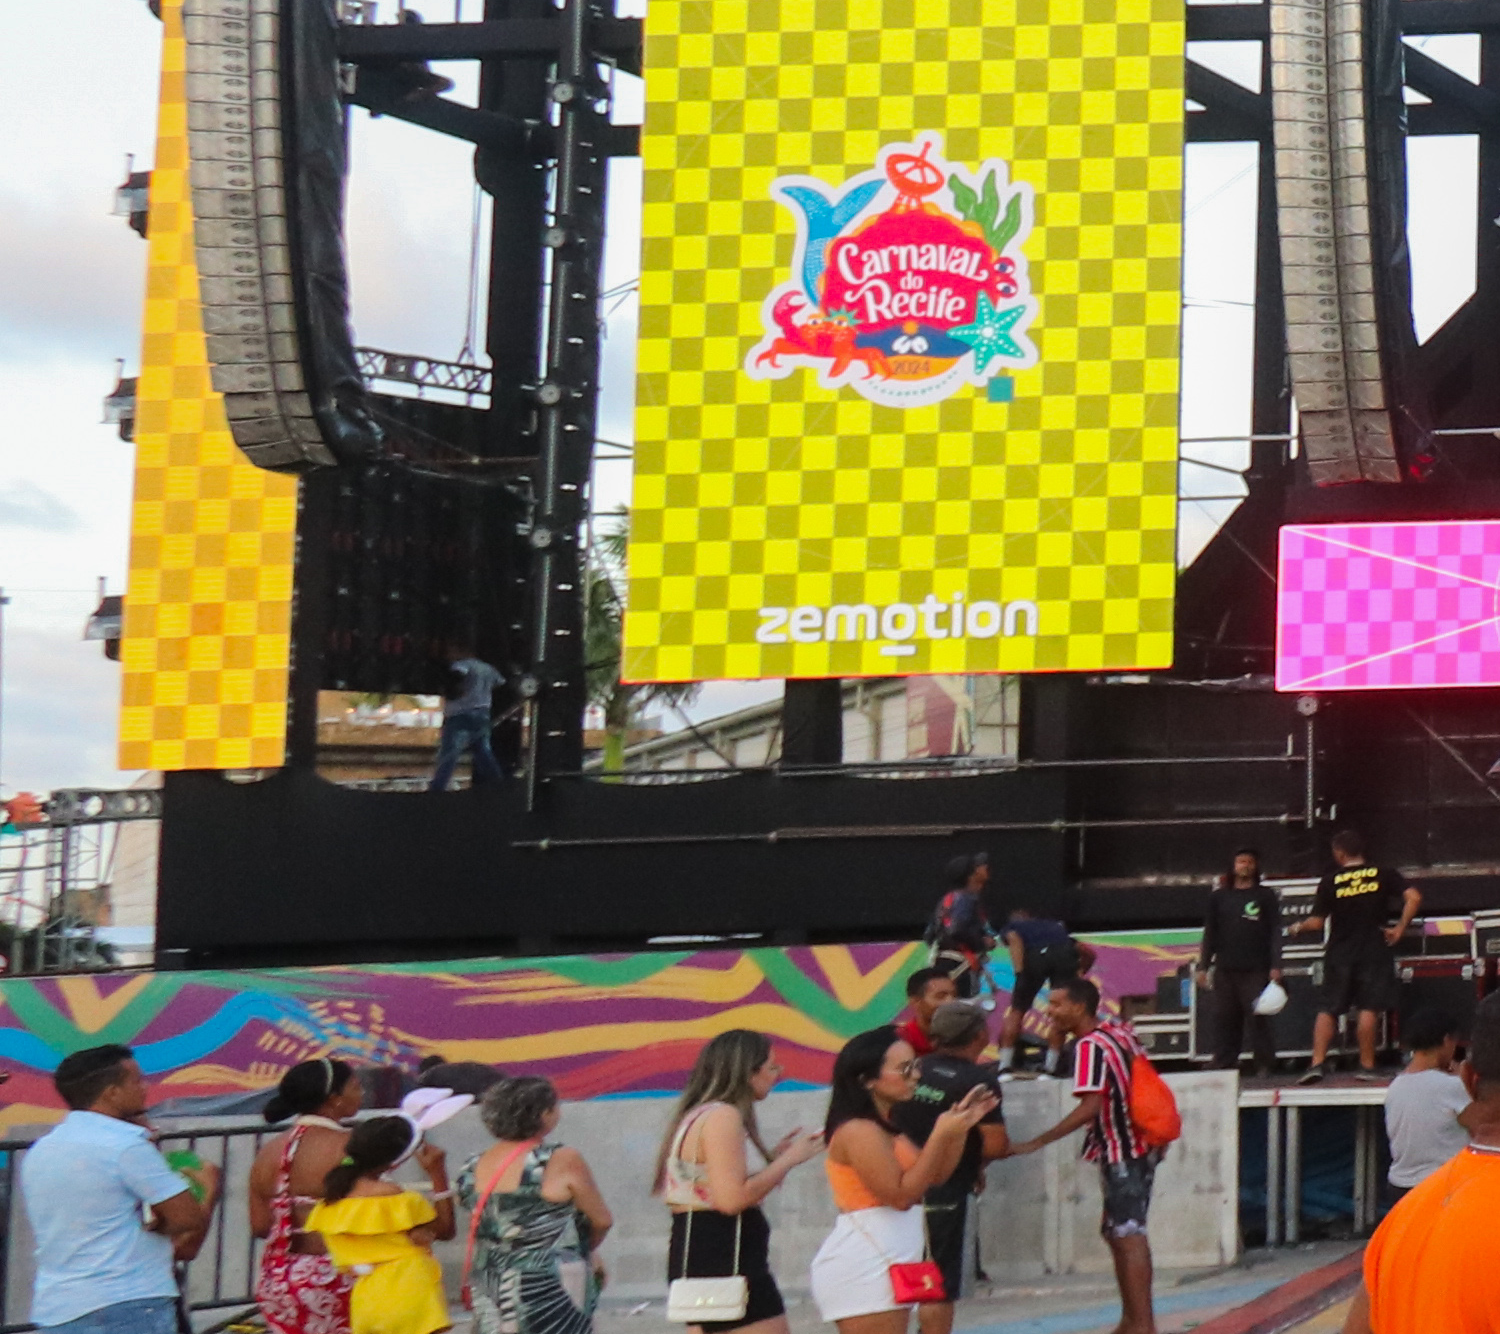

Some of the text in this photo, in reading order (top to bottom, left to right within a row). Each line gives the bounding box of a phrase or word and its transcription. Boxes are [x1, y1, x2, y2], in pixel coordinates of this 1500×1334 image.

[899, 270, 924, 290] do
[843, 278, 966, 323] Recife
[755, 592, 1039, 656] zemotion
[1334, 867, 1378, 885] APOIO
[1335, 882, 1379, 899] PALCO
